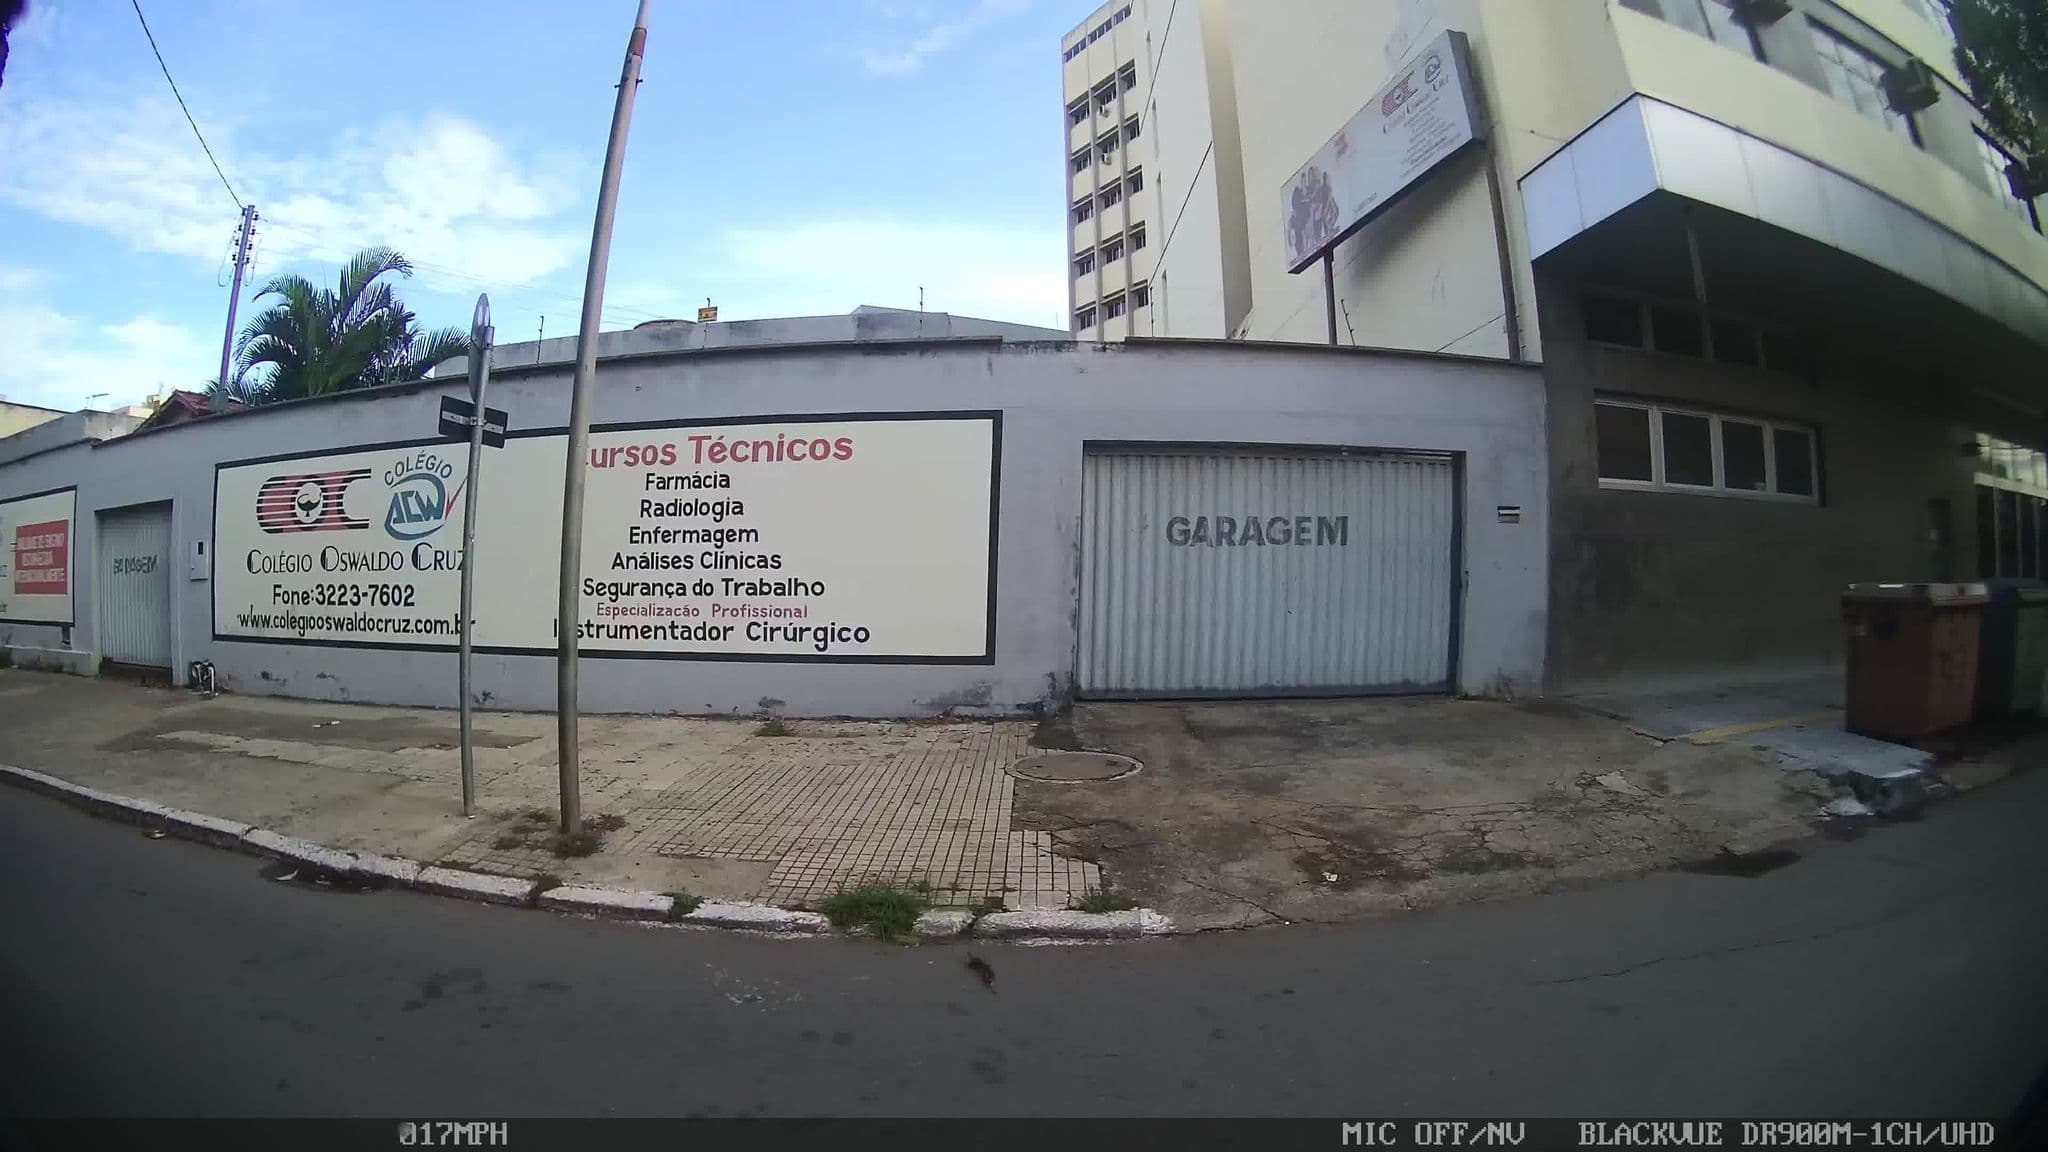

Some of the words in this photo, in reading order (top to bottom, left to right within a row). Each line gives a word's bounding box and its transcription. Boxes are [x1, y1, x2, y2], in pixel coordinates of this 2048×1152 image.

[587, 442, 677, 468] ursos
[688, 433, 853, 464] Técnicos
[384, 450, 453, 486] COLÉGIO
[645, 471, 730, 491] Farmácia
[640, 497, 744, 523] Radiologia
[629, 526, 759, 549] Enfermagem
[1166, 516, 1348, 547] GARAGEM
[247, 549, 312, 574] COLÉGIO
[320, 545, 403, 571] OSWALDO
[611, 552, 694, 570] Análises
[700, 551, 782, 570] Clínicas
[272, 584, 415, 607] Fone:3223-7602
[583, 578, 687, 602] Segurança
[692, 578, 714, 596] do
[721, 577, 825, 597] Trabalho
[712, 603, 808, 619] Profissional
[553, 618, 734, 642] Istrumentador
[746, 621, 870, 651] Cirúrgico
